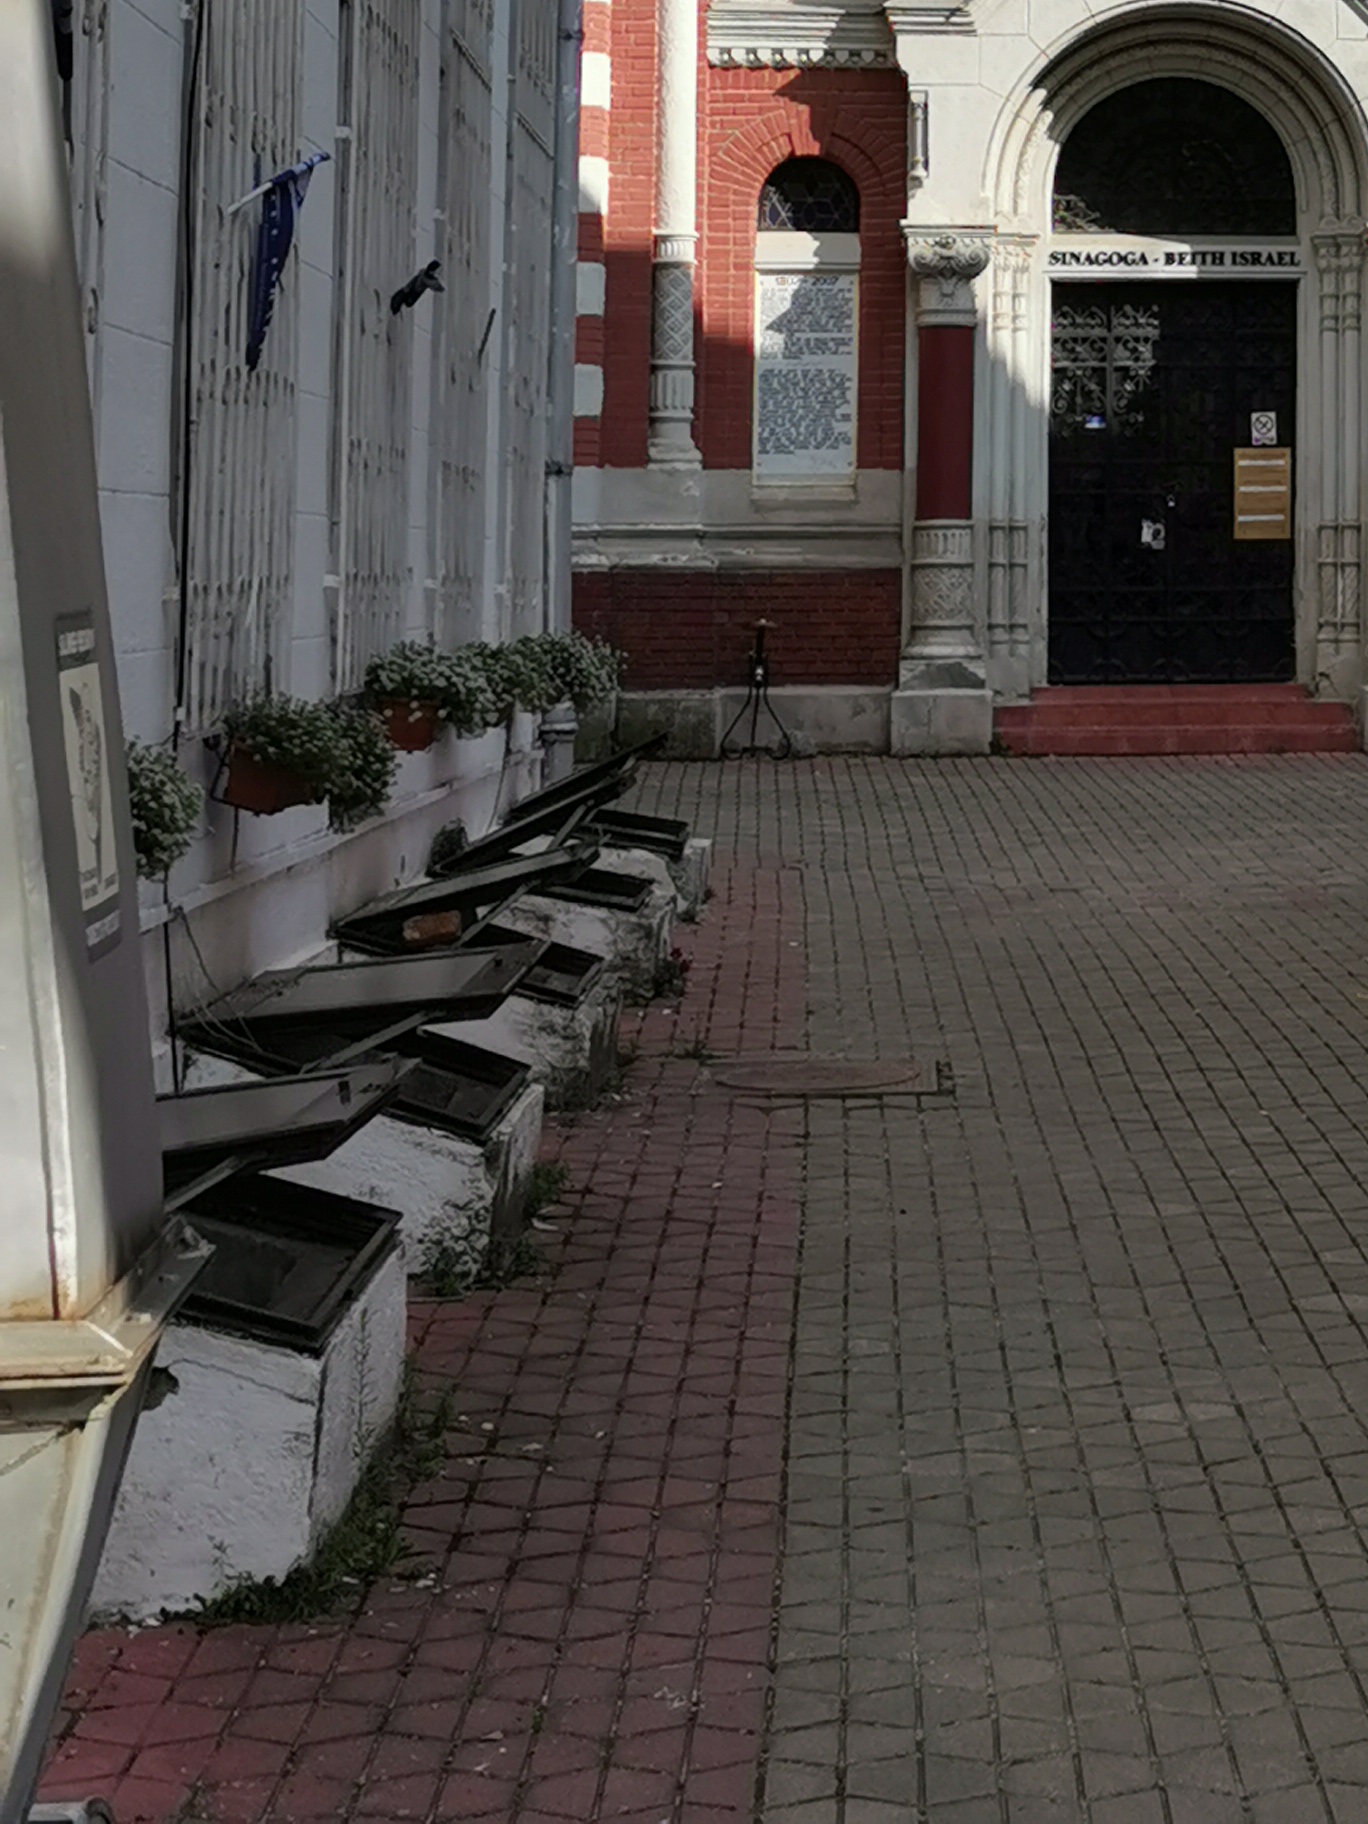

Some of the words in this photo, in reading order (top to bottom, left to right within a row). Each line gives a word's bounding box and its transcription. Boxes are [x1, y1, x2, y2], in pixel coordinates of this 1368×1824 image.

[1048, 251, 1149, 267] SINAGOGA
[1164, 251, 1225, 267] BEITH
[1231, 251, 1301, 267] ISRAEL
